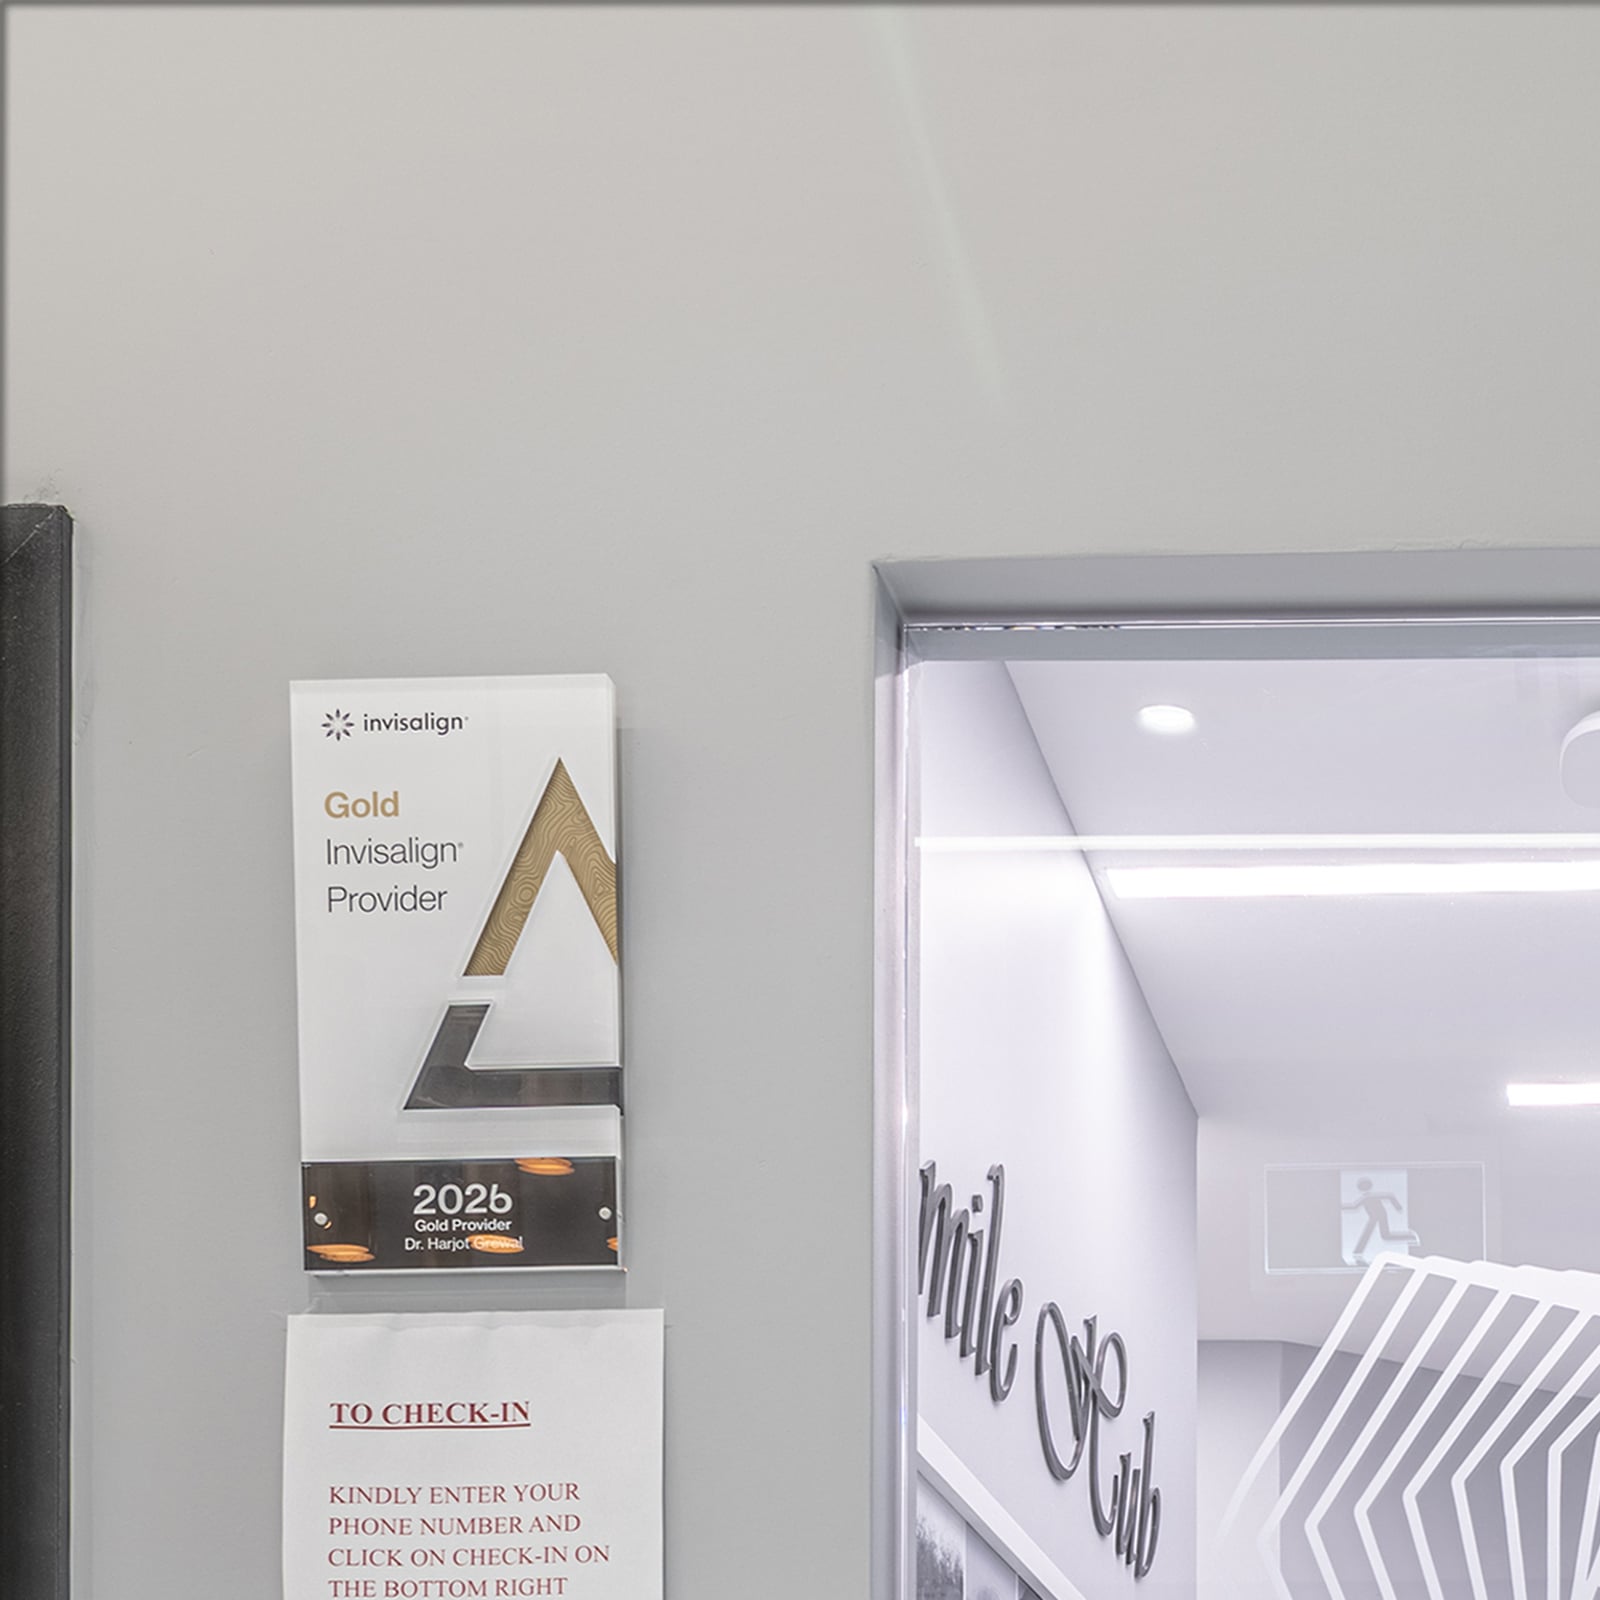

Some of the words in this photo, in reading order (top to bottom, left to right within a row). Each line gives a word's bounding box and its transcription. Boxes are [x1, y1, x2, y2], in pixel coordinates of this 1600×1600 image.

[363, 712, 464, 736] invisalign
[324, 790, 400, 819] Gold
[326, 836, 458, 870] Invisalign
[327, 884, 449, 914] Provider
[412, 1182, 513, 1216] 2026
[414, 1218, 449, 1233] Gold
[452, 1217, 513, 1231] Provider
[404, 1236, 425, 1251] Dr.
[427, 1236, 471, 1252] Harjot
[918, 1159, 1023, 1403] mile
[329, 1402, 373, 1426] TO
[381, 1399, 531, 1426] CHECK-IN
[328, 1484, 422, 1507] KINDLY
[429, 1484, 507, 1505] ENTER
[512, 1482, 581, 1503] YOUR
[328, 1516, 413, 1537] PHONE
[419, 1515, 524, 1536] NUMBER
[528, 1513, 582, 1535] AND
[327, 1547, 404, 1569] CLICK
[410, 1547, 447, 1568] ON
[452, 1545, 569, 1567] CHECK-IN
[574, 1544, 610, 1565] ON
[328, 1579, 377, 1600] THE
[383, 1578, 488, 1600] BOTTOM
[495, 1576, 568, 1598] RIGHT
